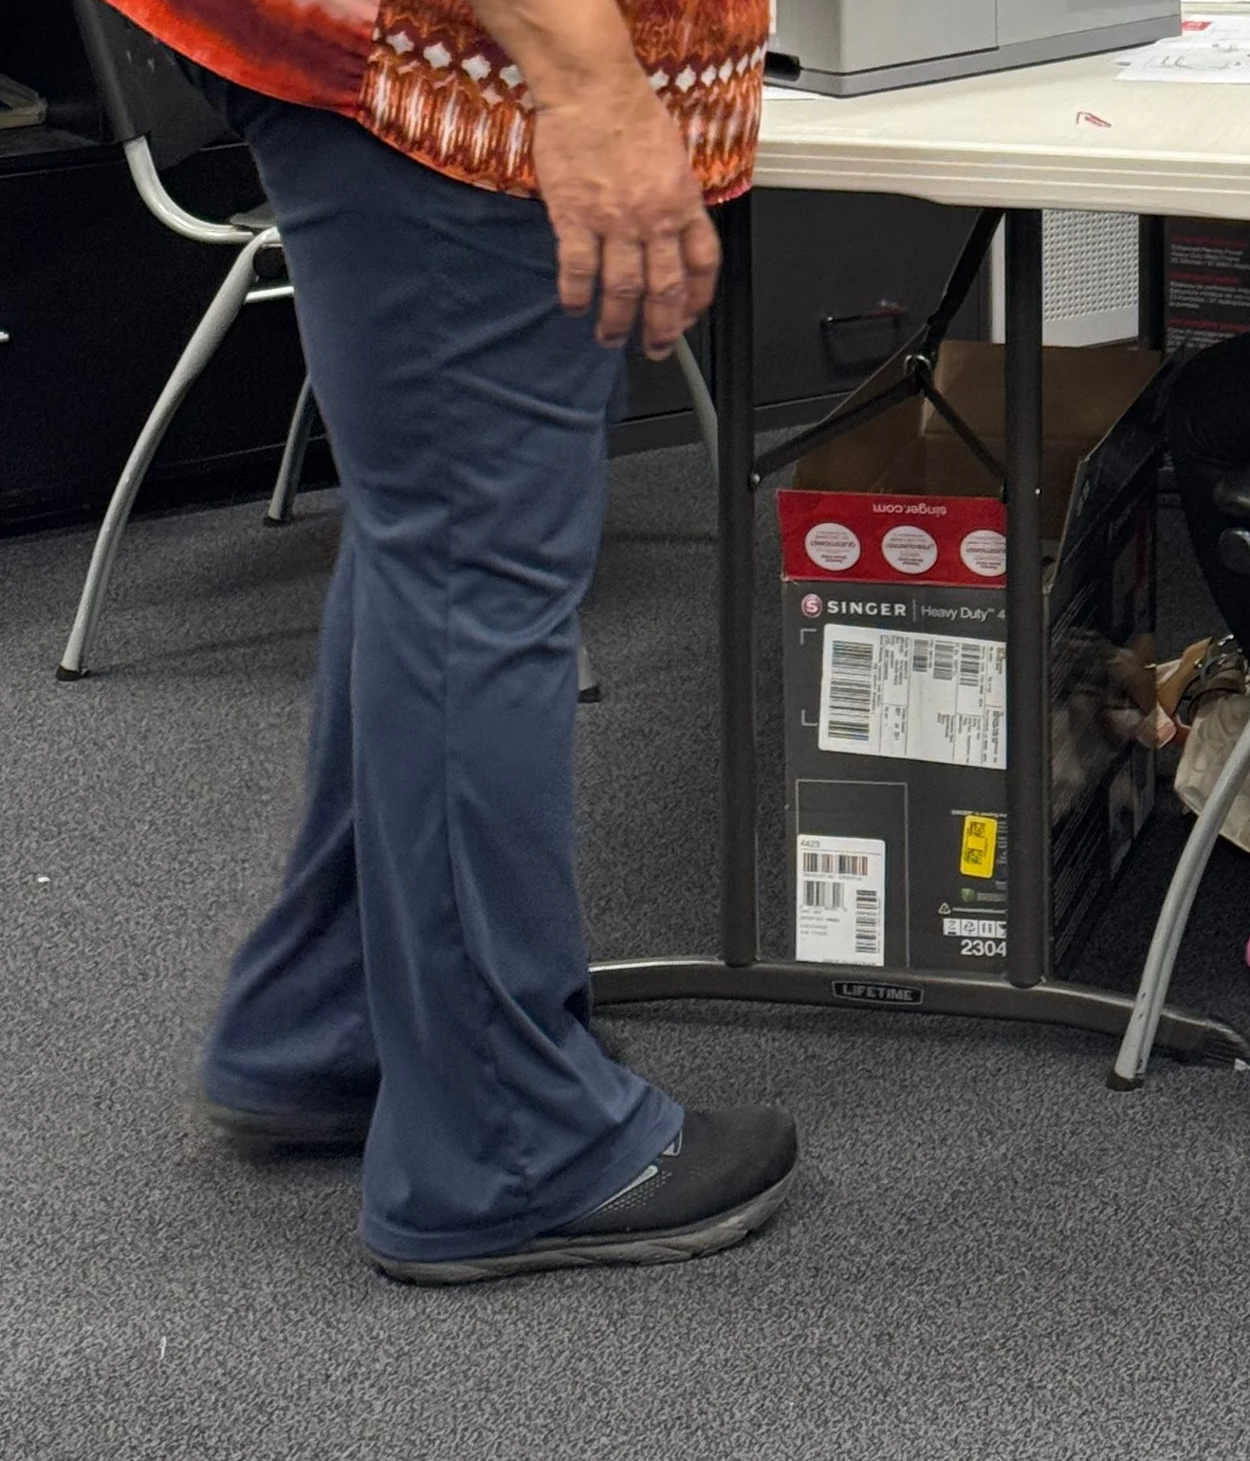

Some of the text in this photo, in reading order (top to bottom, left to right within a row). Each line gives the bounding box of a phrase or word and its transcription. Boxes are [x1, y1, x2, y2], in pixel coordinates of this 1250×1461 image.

[872, 502, 947, 517] singer.com
[827, 600, 907, 618] SINGER
[921, 605, 957, 620] Heavy
[841, 983, 913, 1002] LIFETIME
